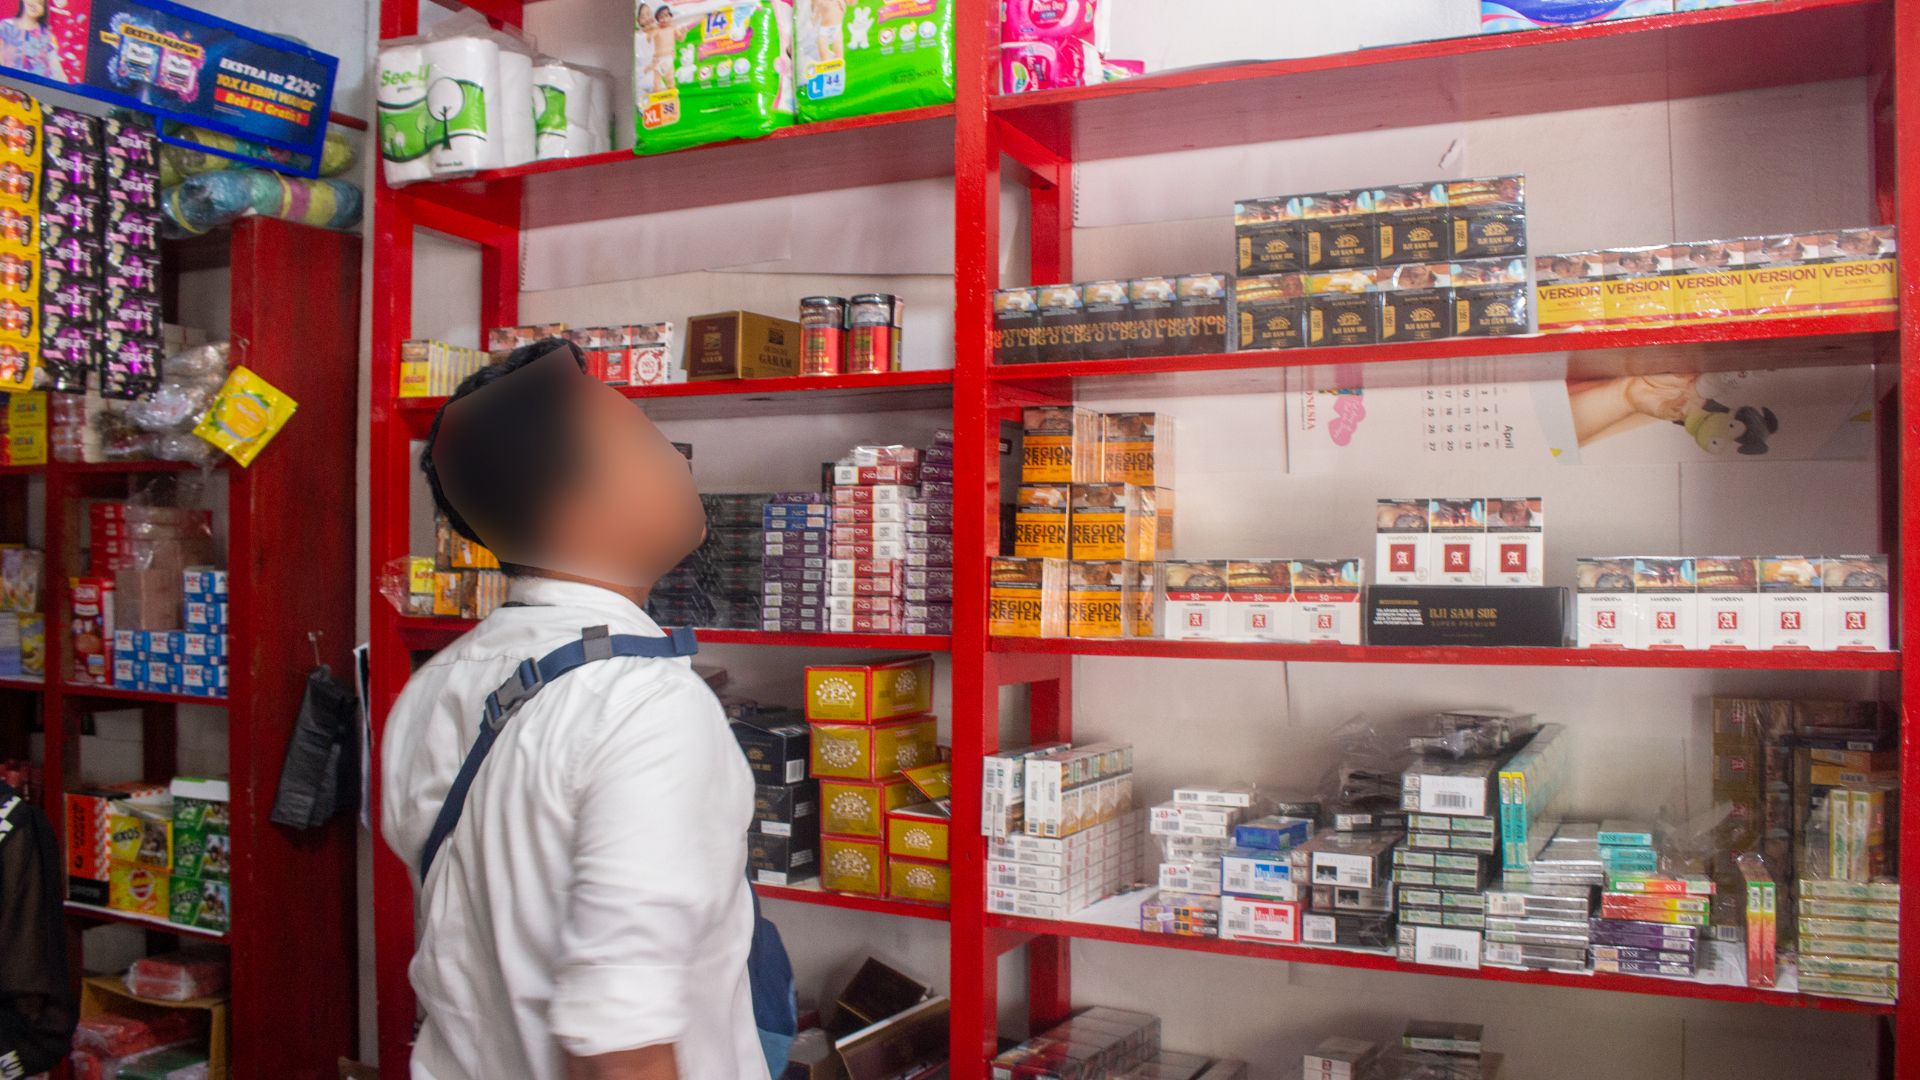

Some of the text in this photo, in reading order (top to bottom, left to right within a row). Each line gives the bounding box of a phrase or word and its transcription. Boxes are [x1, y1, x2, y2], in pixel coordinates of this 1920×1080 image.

[220, 57, 267, 80] EKSTRA
[268, 72, 285, 84] ISI
[217, 73, 240, 89] 10X
[240, 80, 278, 101] LEBIH
[812, 81, 821, 94] L
[225, 93, 250, 106] Beli
[266, 104, 295, 121] Gratis
[644, 111, 661, 125] XL
[1749, 268, 1816, 284] VERSION
[1823, 262, 1894, 279] VERSION
[1606, 280, 1670, 294] VERSION
[1676, 275, 1741, 290] VERSION
[1539, 286, 1601, 300] VERSION
[759, 355, 793, 368] GARAM
[1503, 424, 1515, 449] April
[1024, 447, 1072, 456] REGION
[1106, 453, 1154, 462] REGION
[1023, 457, 1072, 466] KRETEK
[1106, 463, 1154, 471] KRETEK
[1016, 524, 1066, 534] REGION
[1073, 524, 1125, 536] REGION
[1016, 535, 1066, 543] KRETEK
[1072, 535, 1125, 544] KRETEK
[991, 600, 1041, 611] REGION
[1070, 602, 1121, 613] REGION
[990, 611, 1041, 621] KRETEK
[1070, 613, 1121, 622] KRETEK
[1451, 608, 1474, 619] SAM
